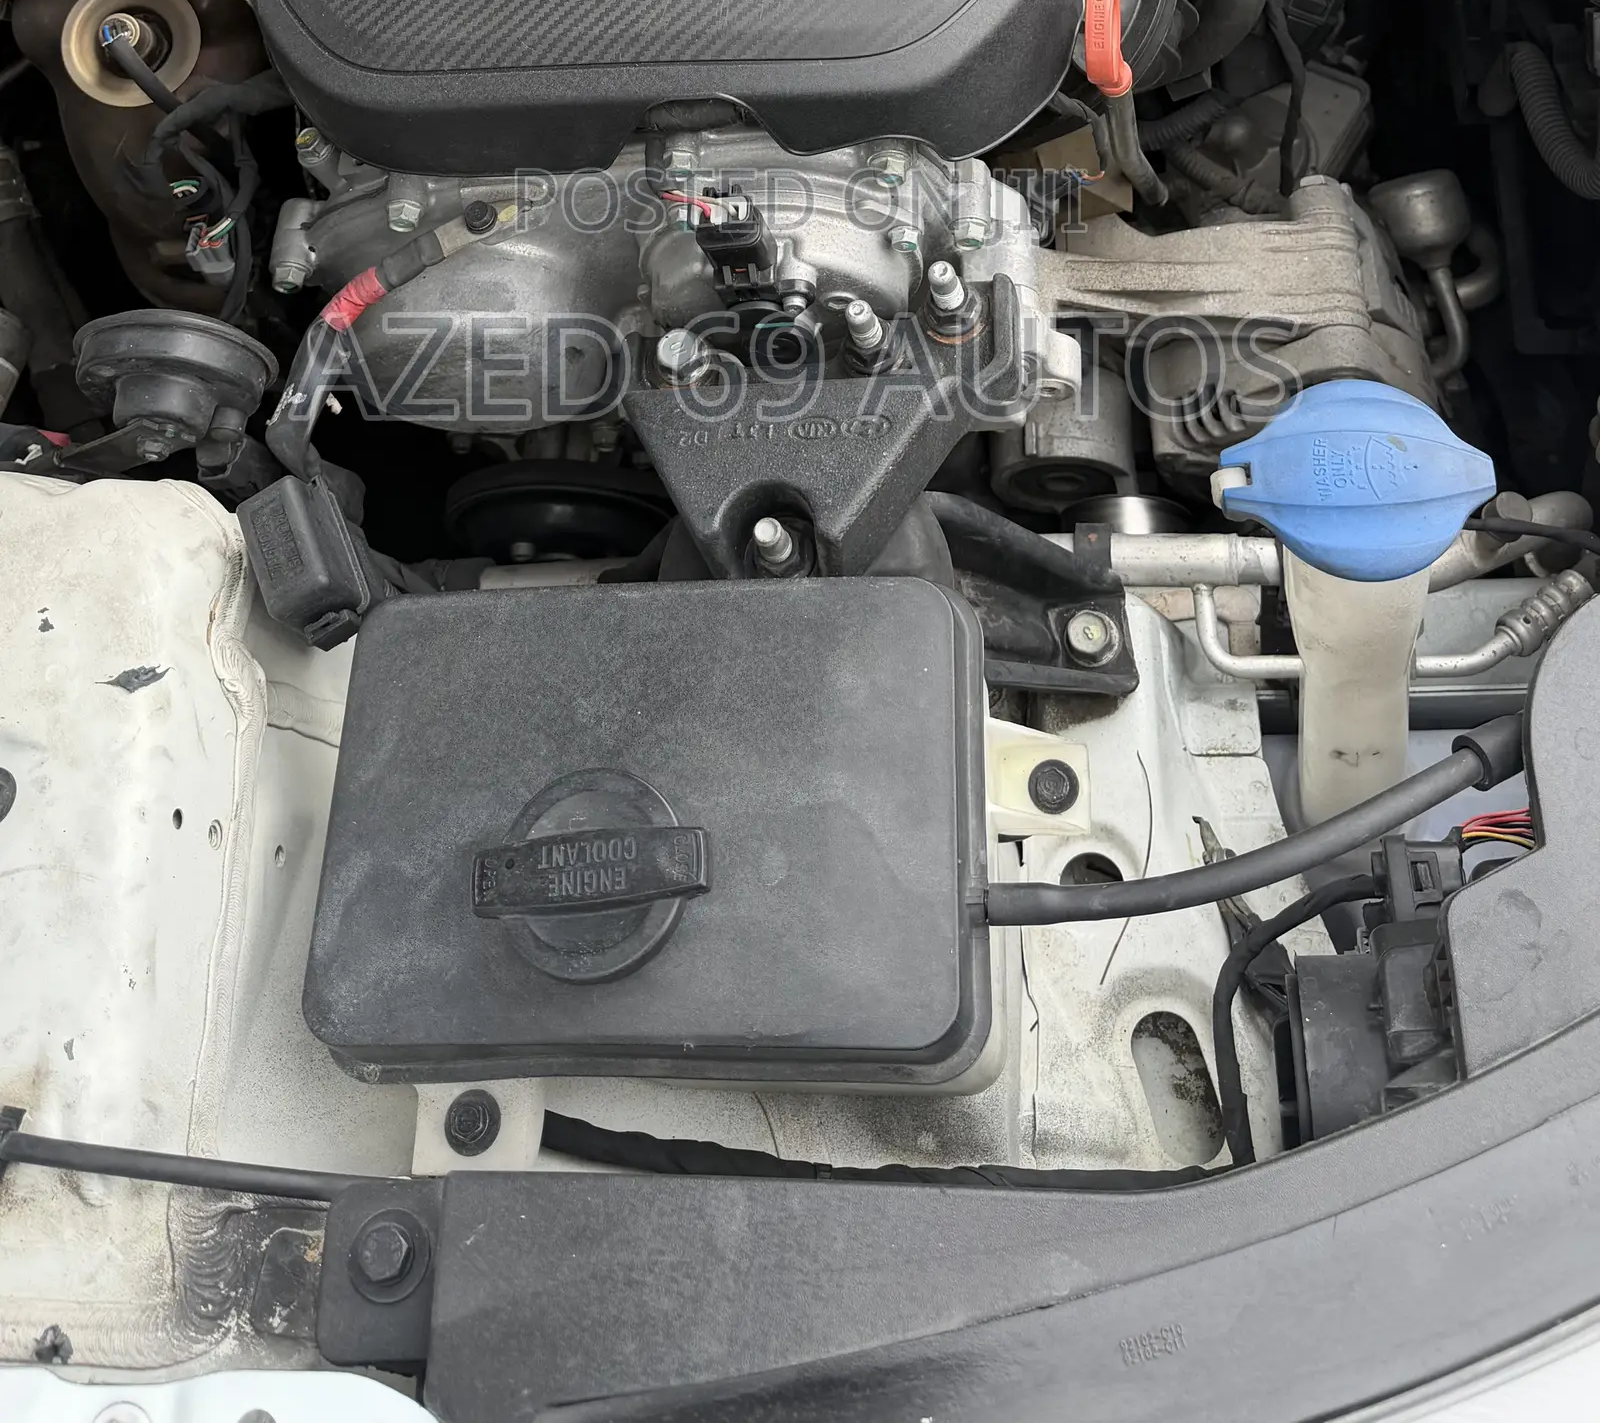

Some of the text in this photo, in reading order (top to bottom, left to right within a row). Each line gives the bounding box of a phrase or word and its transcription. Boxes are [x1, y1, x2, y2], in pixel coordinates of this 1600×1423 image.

[1093, 4, 1105, 50] ENGINE
[1312, 437, 1334, 501] WASHER
[1331, 450, 1347, 489] ONLY
[537, 836, 637, 870] COOLANT
[673, 834, 689, 882] CLOSE
[548, 865, 627, 898] ENGINE
